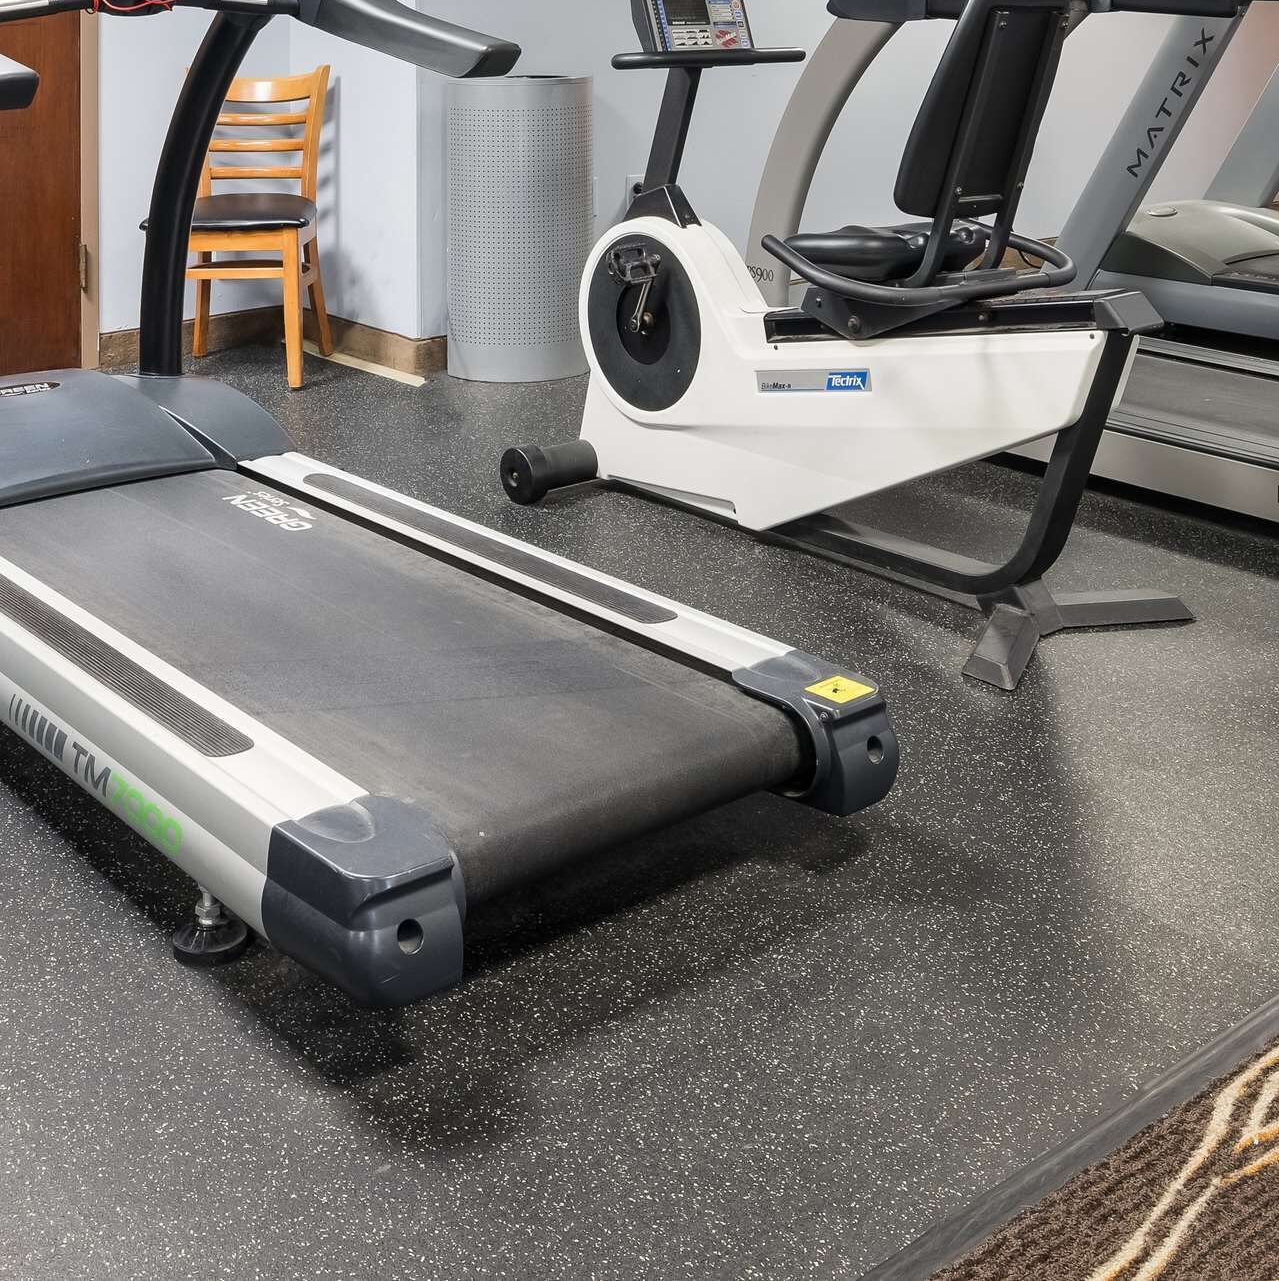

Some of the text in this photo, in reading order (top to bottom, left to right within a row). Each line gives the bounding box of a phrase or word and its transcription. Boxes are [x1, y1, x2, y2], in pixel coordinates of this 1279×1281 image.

[1126, 27, 1215, 178] MATRIX
[828, 374, 865, 391] Tectrix
[222, 494, 312, 531] GREEN
[72, 741, 184, 857] TM7000
